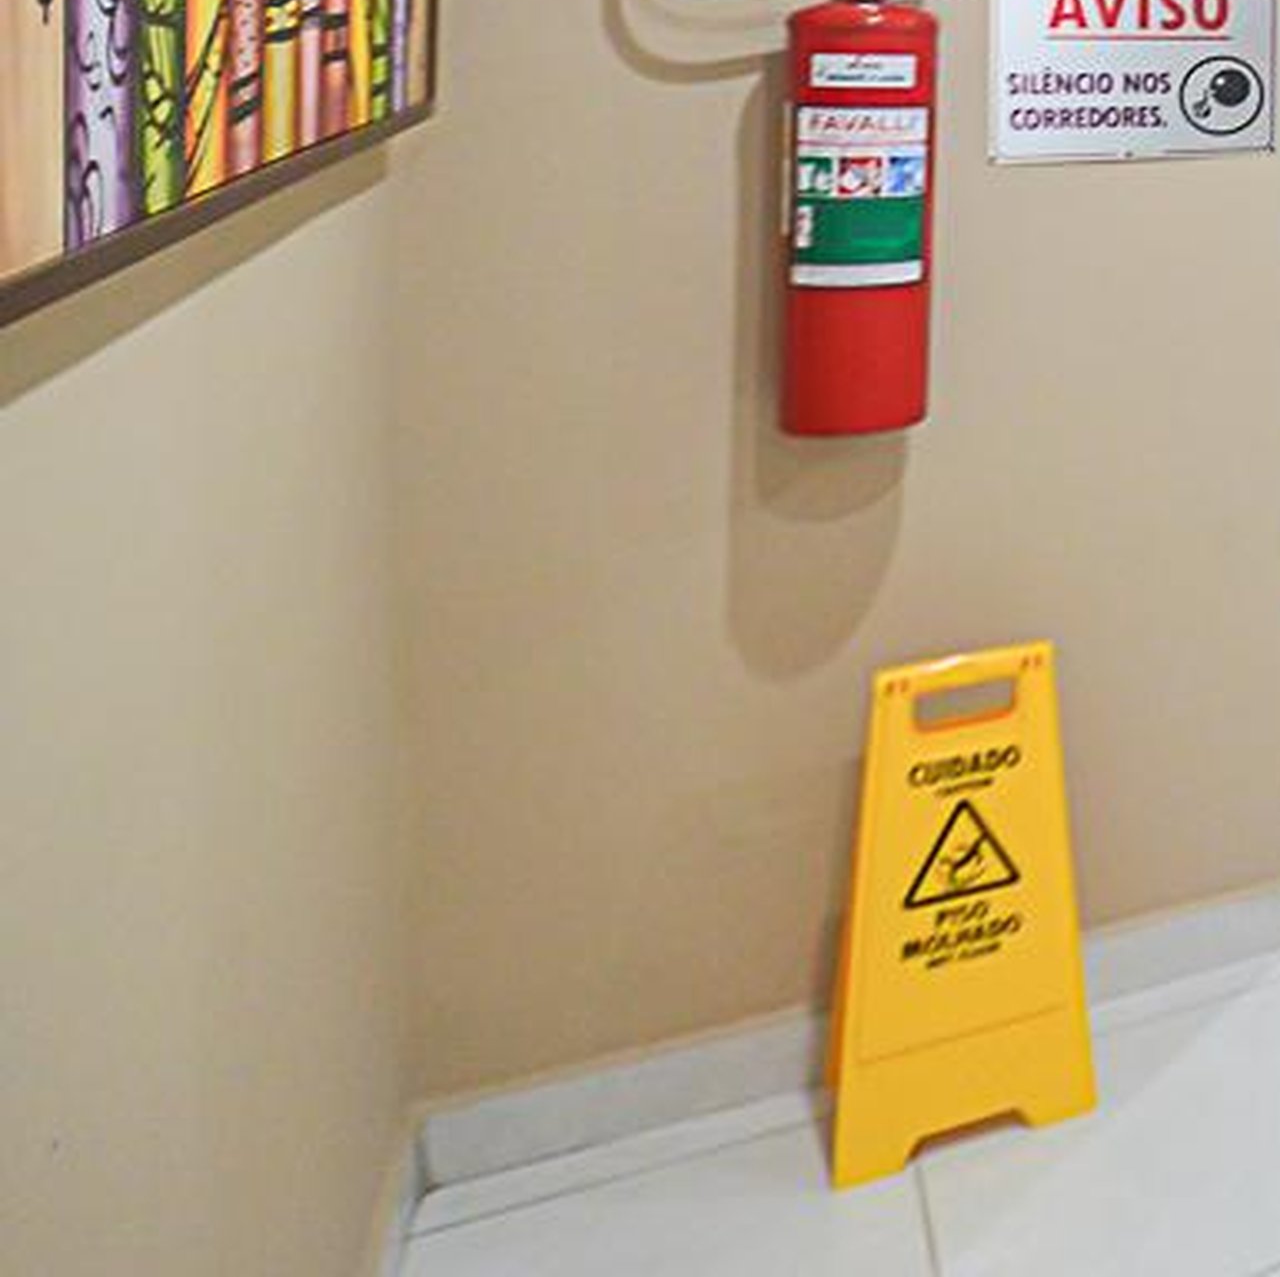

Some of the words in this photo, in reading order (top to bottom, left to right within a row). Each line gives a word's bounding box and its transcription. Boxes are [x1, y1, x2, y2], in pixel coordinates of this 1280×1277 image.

[1009, 67, 1115, 96] SILÊNCIO
[1122, 72, 1172, 95] NOS
[1010, 107, 1168, 130] CORREDORES.
[907, 744, 1022, 788] CUIDADO
[936, 901, 990, 927] PISO
[901, 915, 1022, 960] MOLHADO
